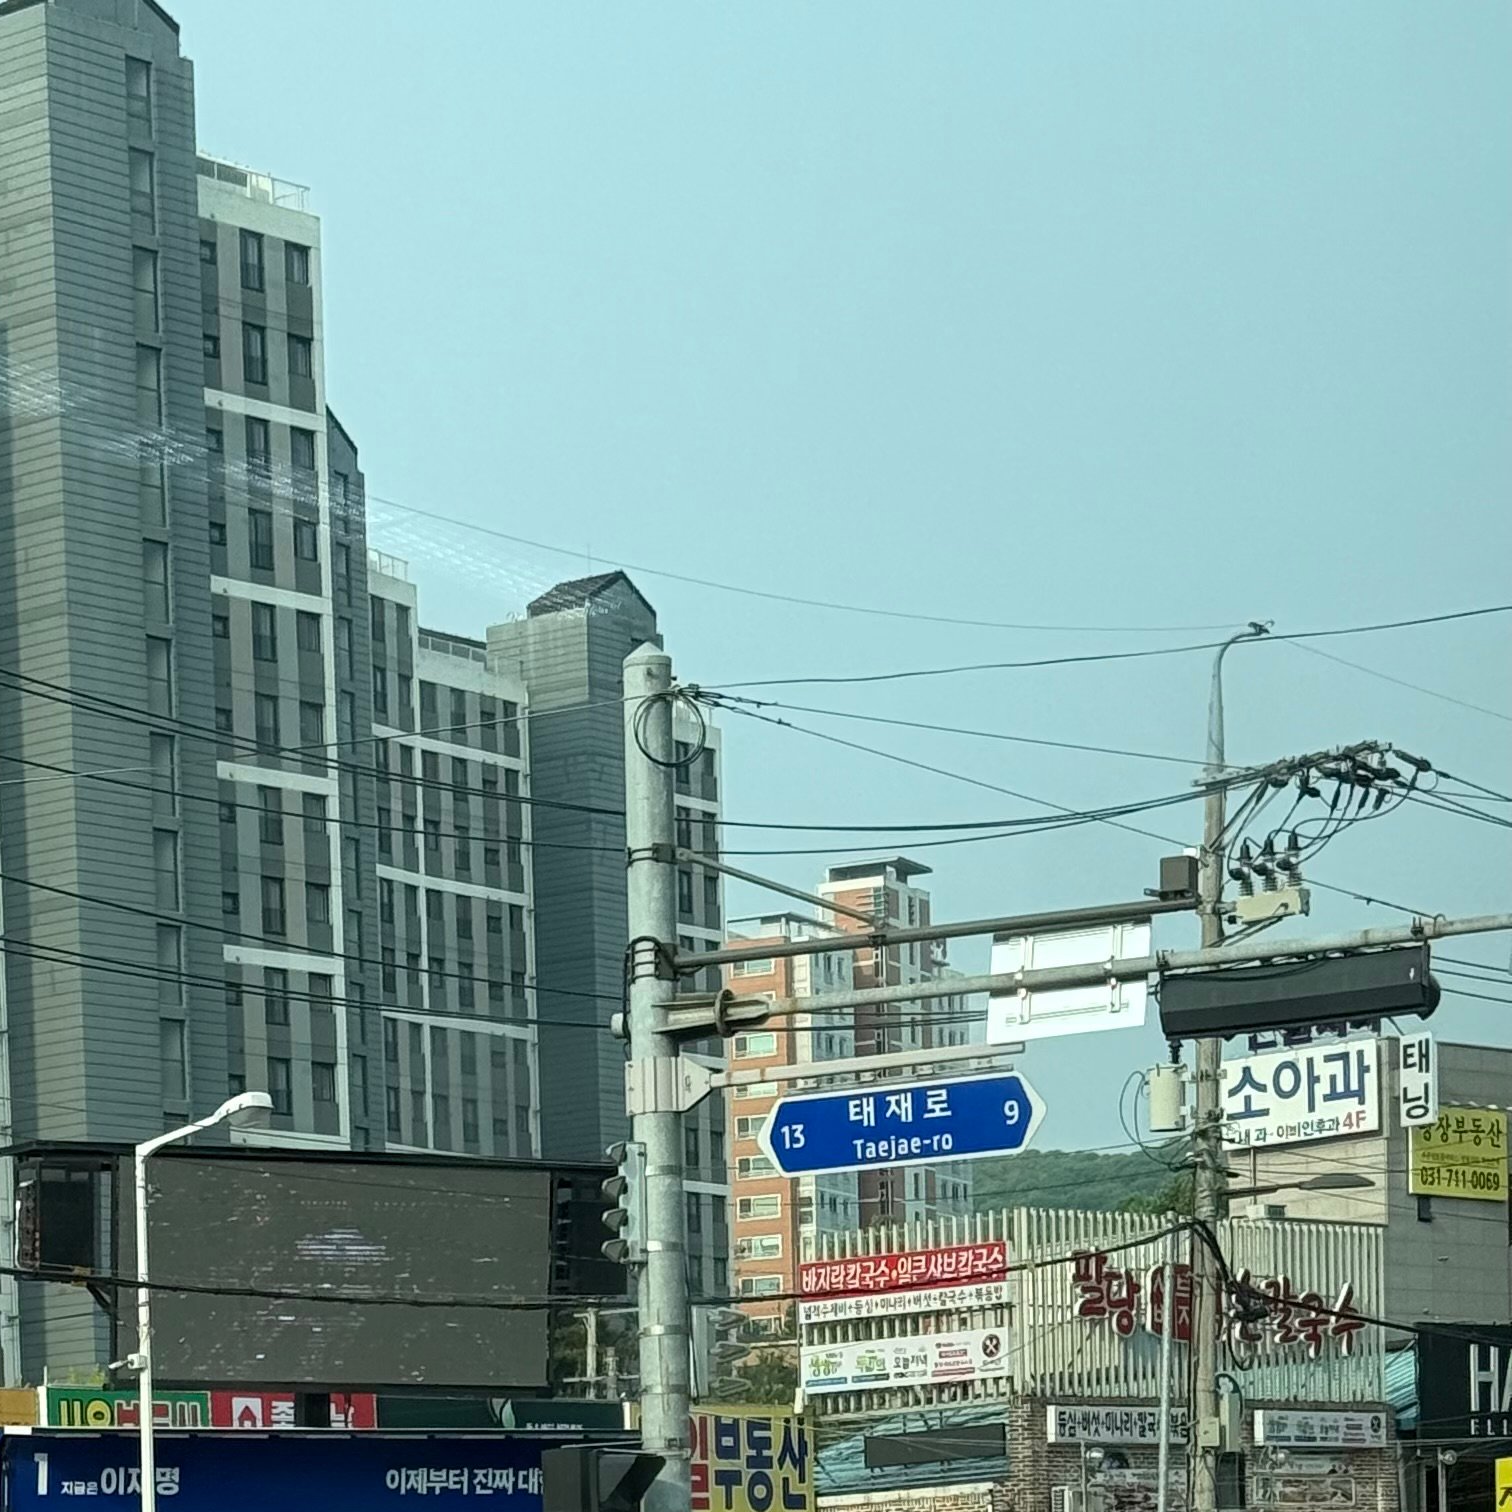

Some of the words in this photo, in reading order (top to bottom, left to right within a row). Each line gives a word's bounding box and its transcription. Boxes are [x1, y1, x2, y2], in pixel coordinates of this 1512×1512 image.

[1226, 1049, 1370, 1121] 소아과
[1402, 1037, 1431, 1120] 태닝
[848, 1089, 952, 1127] 태재로
[1004, 1099, 1020, 1125] 9
[1343, 1110, 1367, 1129] 4F
[780, 1124, 806, 1149] 13
[852, 1132, 954, 1161] Taejae-ro
[34, 1453, 48, 1495] 1
[386, 1467, 468, 1495] 이제부터
[473, 1467, 515, 1495] 진짜
[517, 1467, 543, 1495] 대
